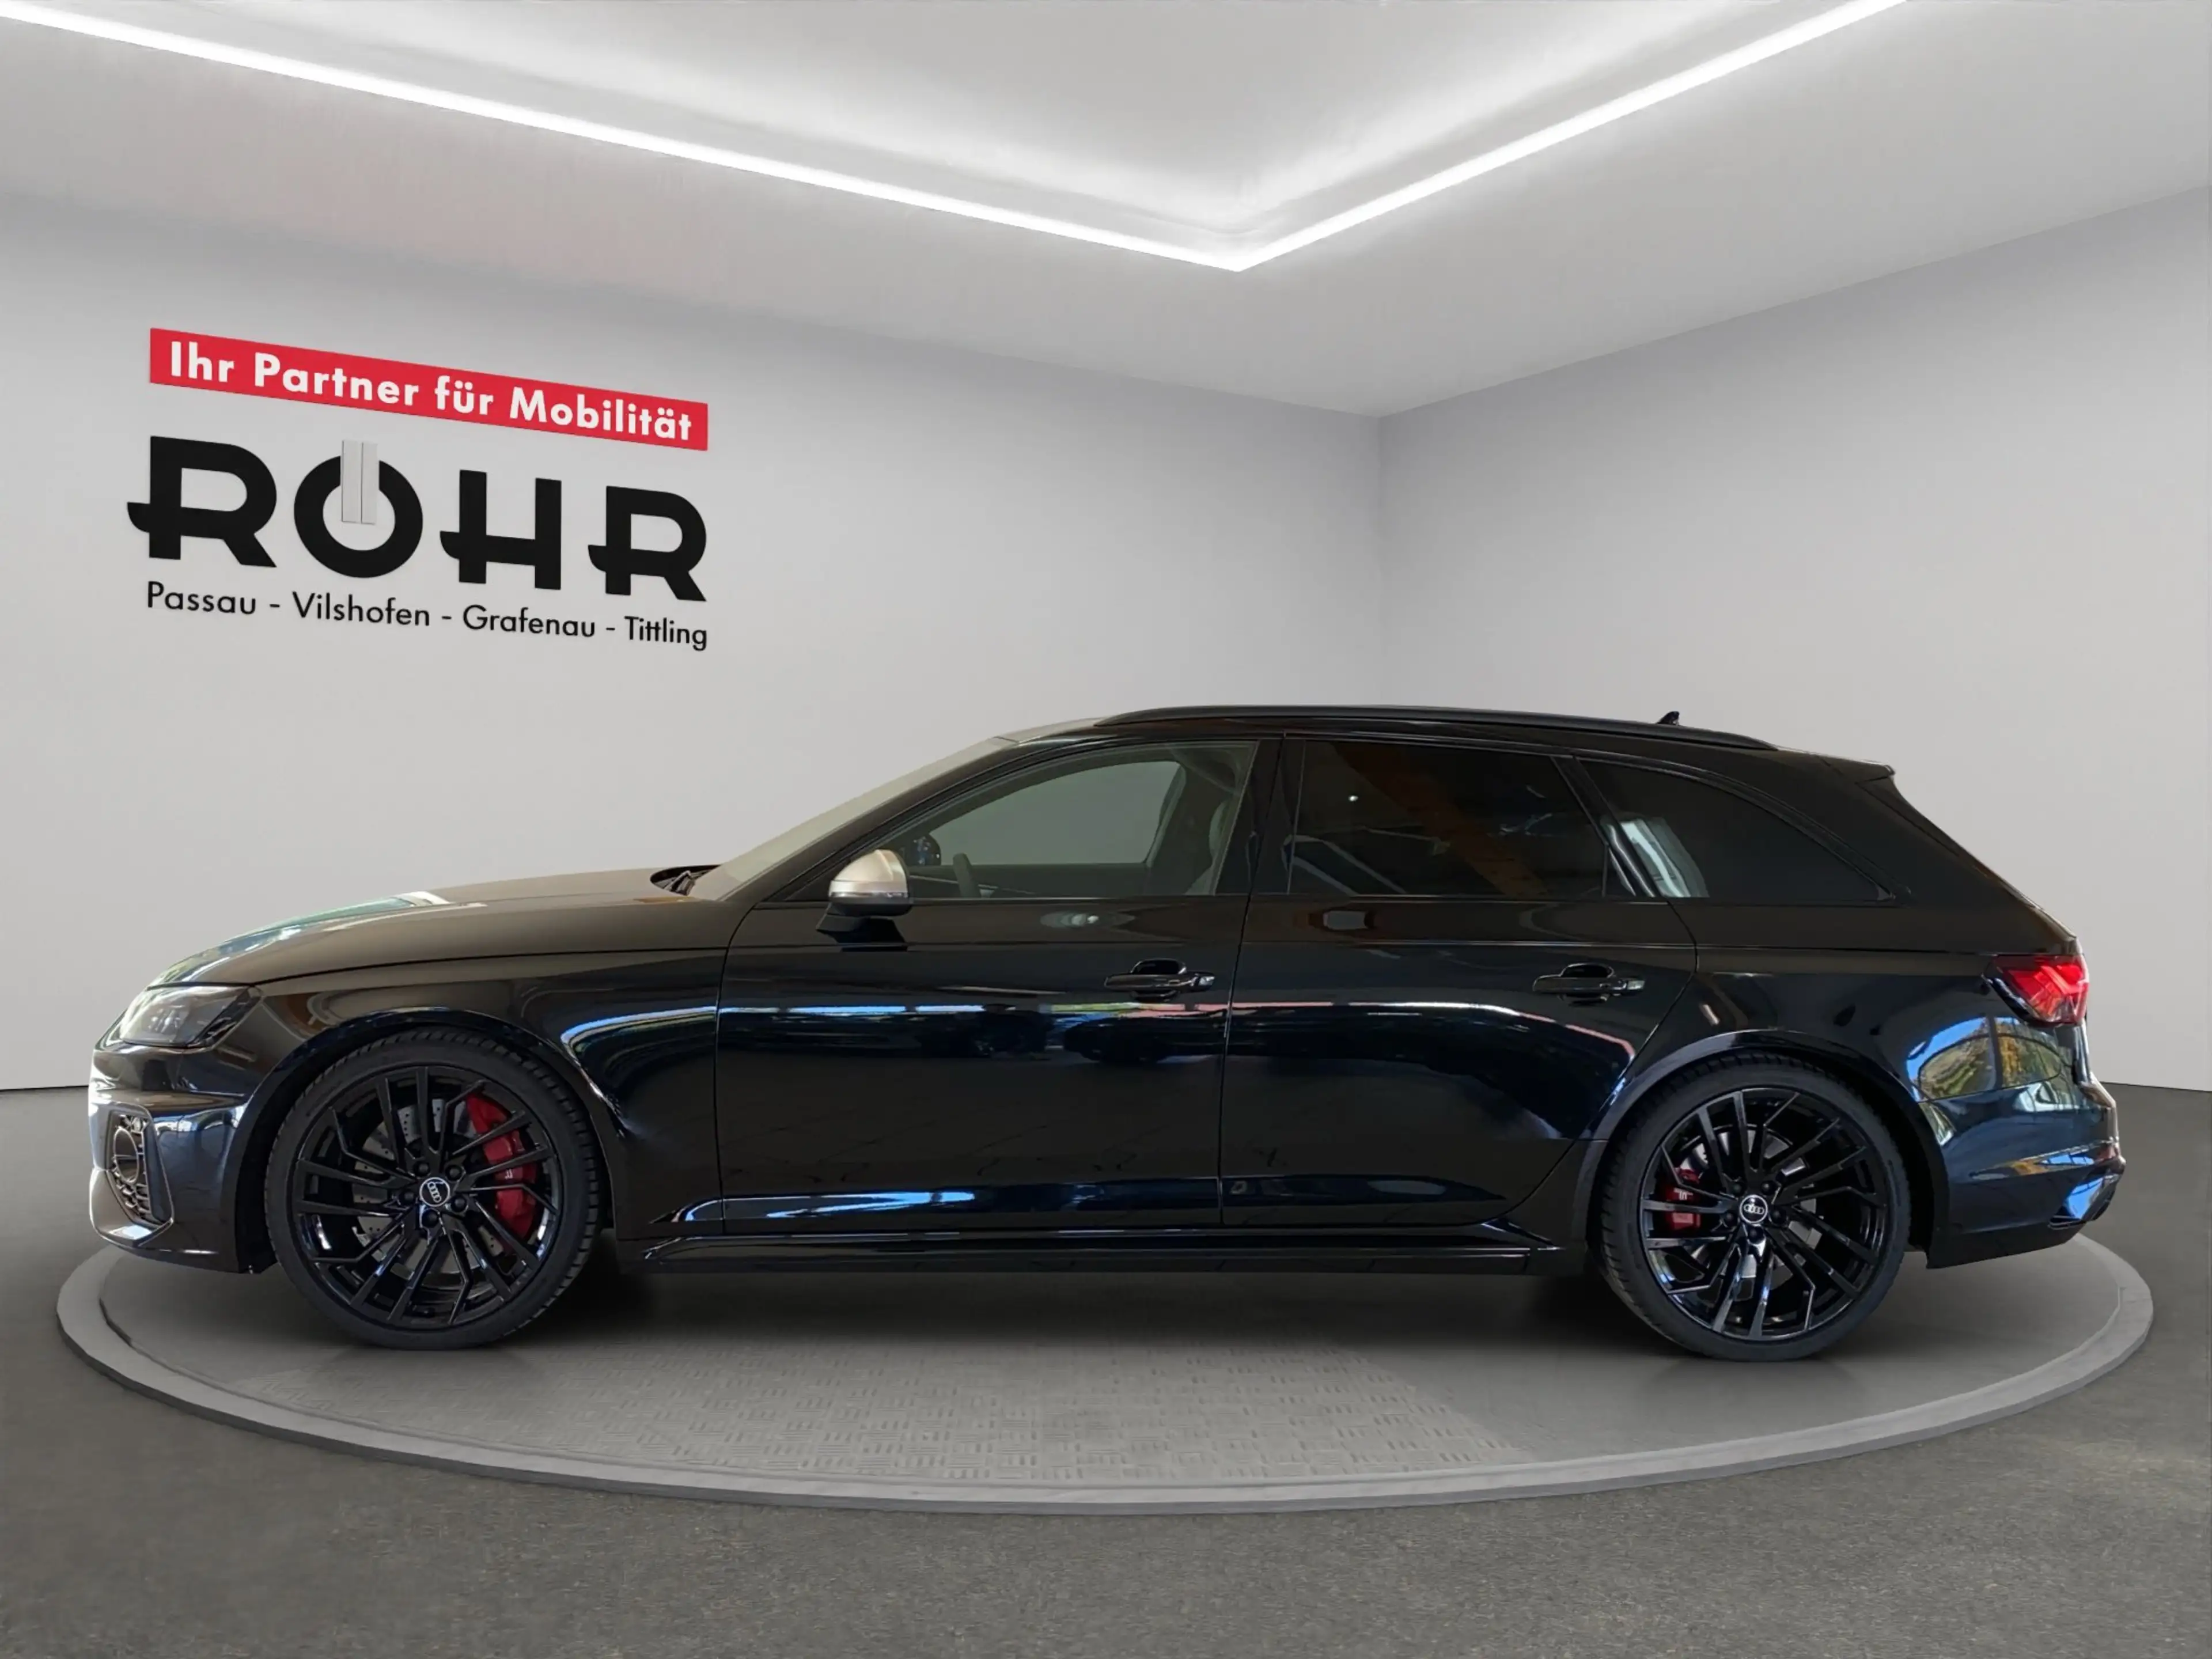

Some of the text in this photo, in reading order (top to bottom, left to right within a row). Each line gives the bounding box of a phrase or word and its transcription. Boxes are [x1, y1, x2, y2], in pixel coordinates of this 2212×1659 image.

[172, 341, 691, 440] Ihr Partner für Mobilität
[147, 581, 256, 615] Passau
[292, 591, 430, 626] Vilshofen
[463, 604, 595, 638] Grafenau
[624, 616, 707, 652] Tittling
